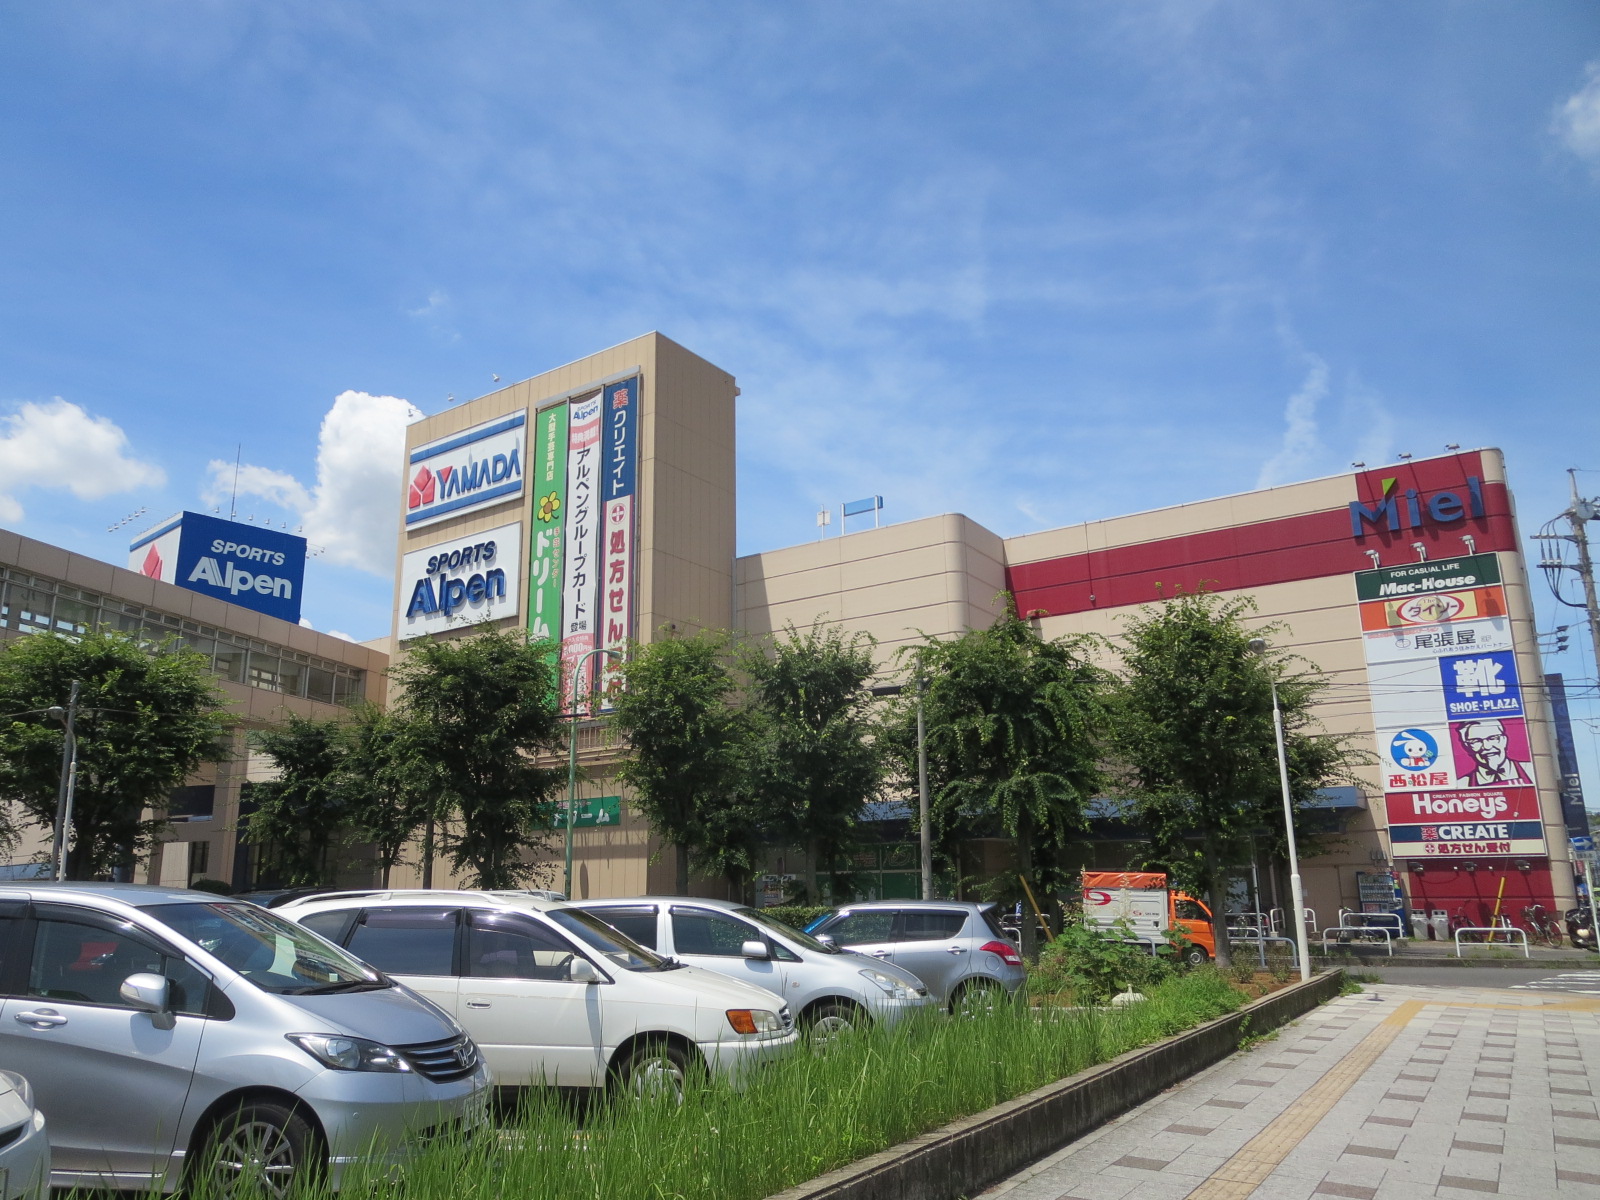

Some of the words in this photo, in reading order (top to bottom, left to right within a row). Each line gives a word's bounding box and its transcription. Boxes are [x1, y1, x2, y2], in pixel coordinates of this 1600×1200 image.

[573, 404, 599, 420] Alpen
[577, 400, 596, 411] SPORTS
[612, 410, 627, 496] クリエイト
[436, 449, 521, 499] YAMADA
[1349, 476, 1485, 536] Miel
[572, 447, 591, 619] アルペングループカード
[211, 540, 286, 566] SPORTS
[426, 541, 496, 575] SPORTS
[188, 557, 292, 599] Alpen
[1409, 566, 1440, 576] CASUAL
[1442, 563, 1460, 571] LIFE
[406, 567, 506, 618] Alpen
[531, 528, 551, 642] ドリーム
[1379, 575, 1476, 596] Mac-House
[570, 621, 587, 633] 登場
[1414, 629, 1476, 649] 尾張屋
[1453, 658, 1506, 697] 靴
[1388, 772, 1449, 788] 西松屋
[1563, 773, 1583, 806] Miel
[1413, 793, 1508, 819] Honeys
[1438, 824, 1509, 840] CREATE
[1437, 842, 1511, 855] 処方せん受付
